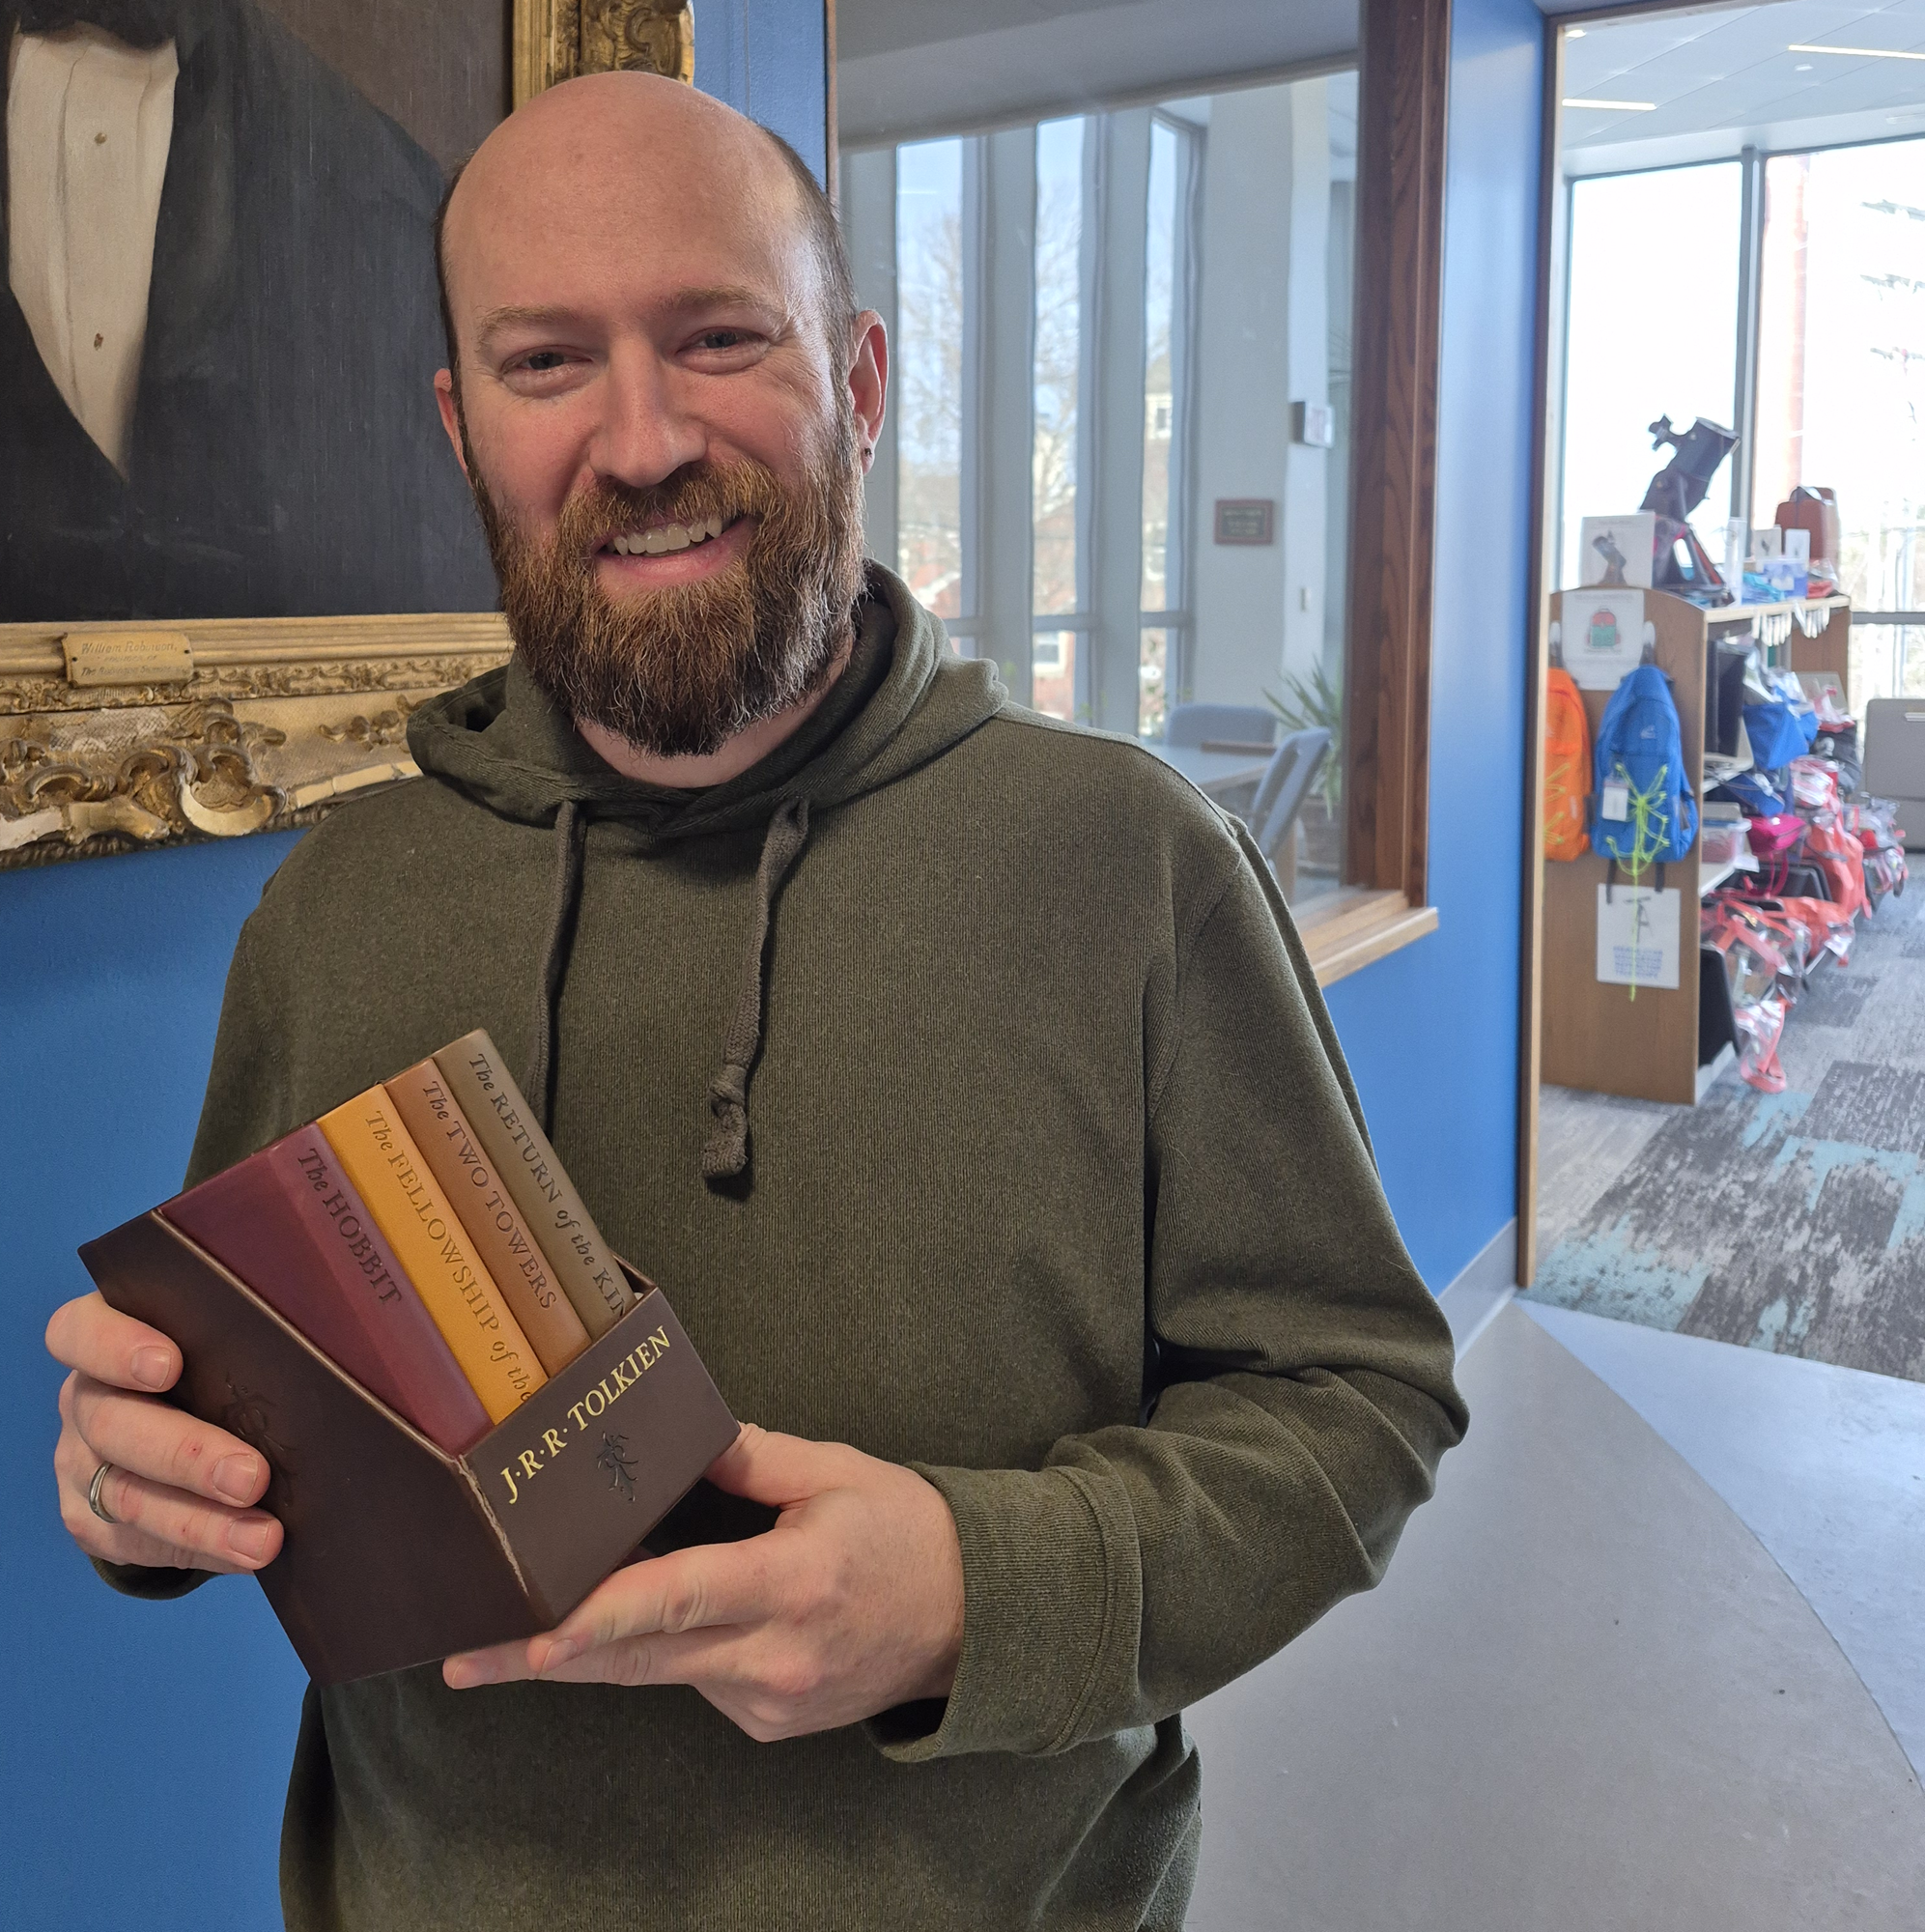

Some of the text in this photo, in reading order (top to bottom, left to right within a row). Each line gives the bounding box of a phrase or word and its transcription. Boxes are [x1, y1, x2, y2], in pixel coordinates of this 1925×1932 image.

[297, 1148, 403, 1304] The HOBBIT
[365, 1110, 532, 1403] The FELLOWSHIP of the
[423, 1080, 557, 1310] The TWO TOWERS
[469, 1053, 626, 1318] The RETURN of the KIN
[567, 1324, 671, 1432] TOLKIEN
